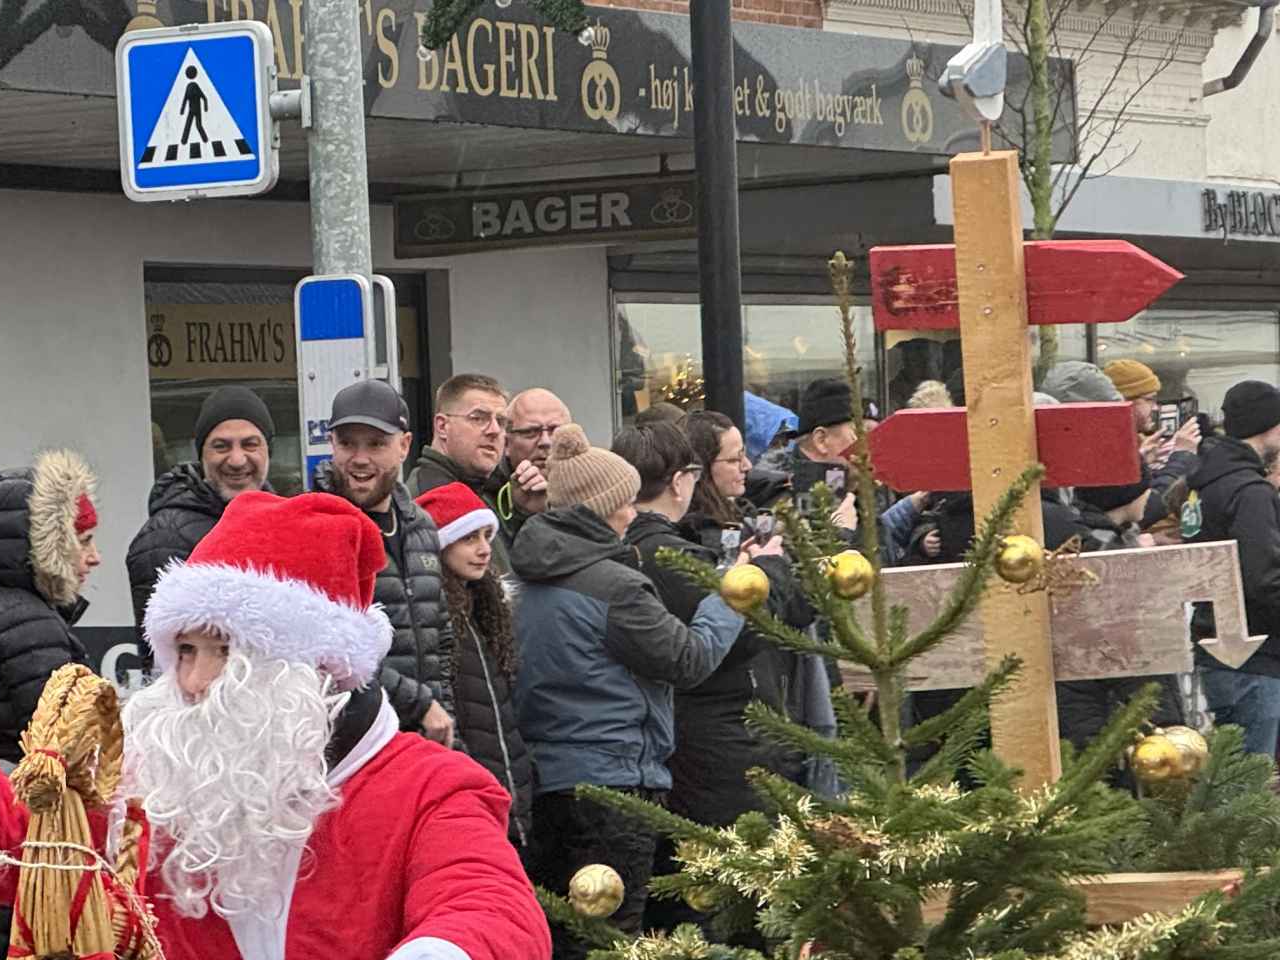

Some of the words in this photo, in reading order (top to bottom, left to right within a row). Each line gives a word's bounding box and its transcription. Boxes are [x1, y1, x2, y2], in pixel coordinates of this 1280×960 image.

[649, 64, 679, 129] høj
[775, 77, 812, 133] godt
[814, 79, 883, 137] bagværk
[472, 192, 632, 238] BAGER
[185, 317, 285, 362] FRAHM'S
